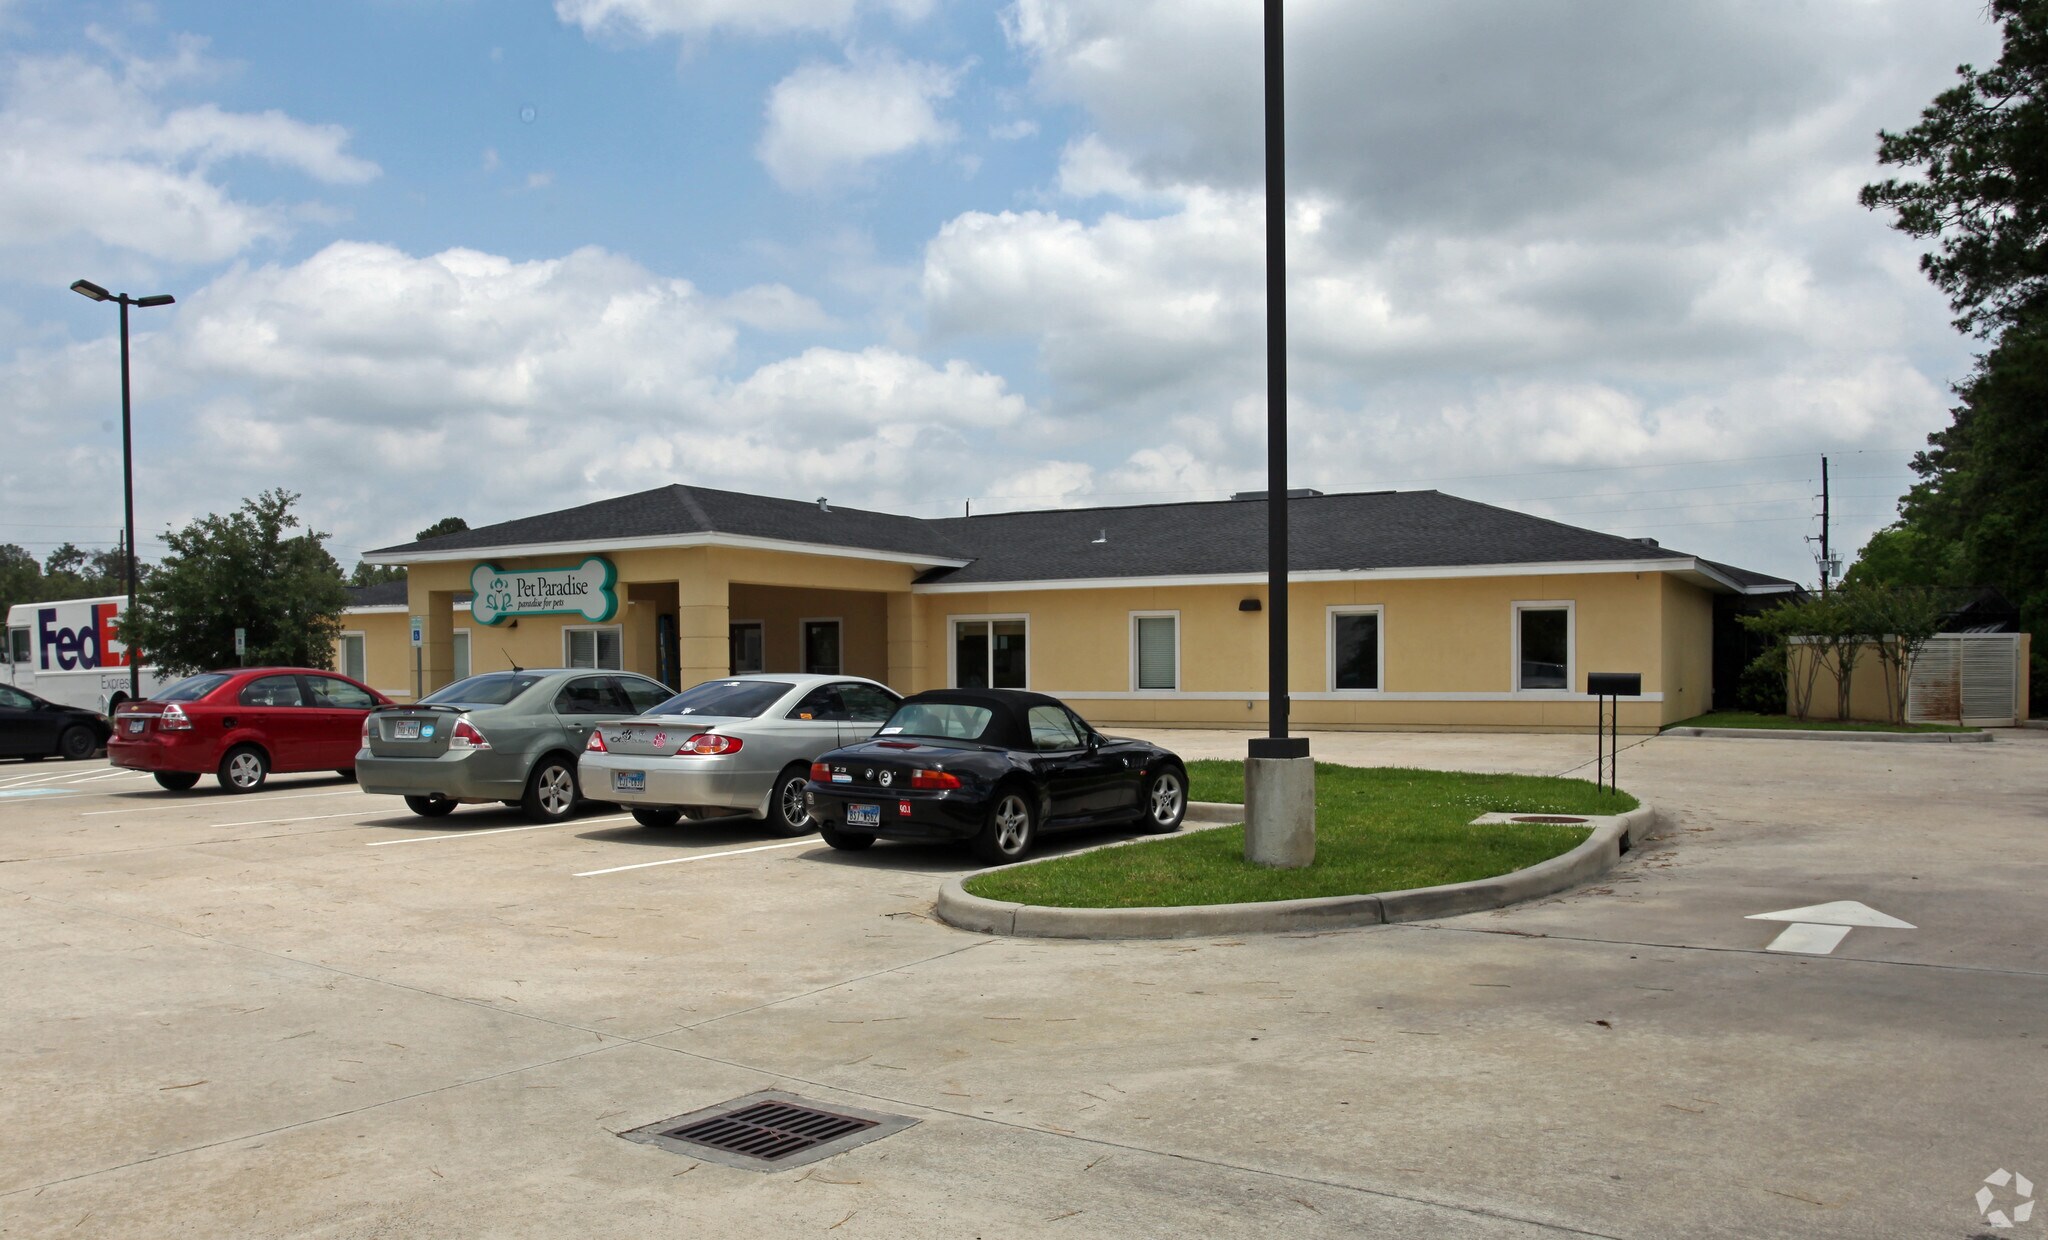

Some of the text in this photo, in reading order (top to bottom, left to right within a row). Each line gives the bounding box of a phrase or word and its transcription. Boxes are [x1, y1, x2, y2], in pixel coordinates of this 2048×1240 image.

[516, 574, 588, 597] Pet Paradise
[517, 596, 565, 610] paradise for pets
[101, 675, 131, 691] Expres
